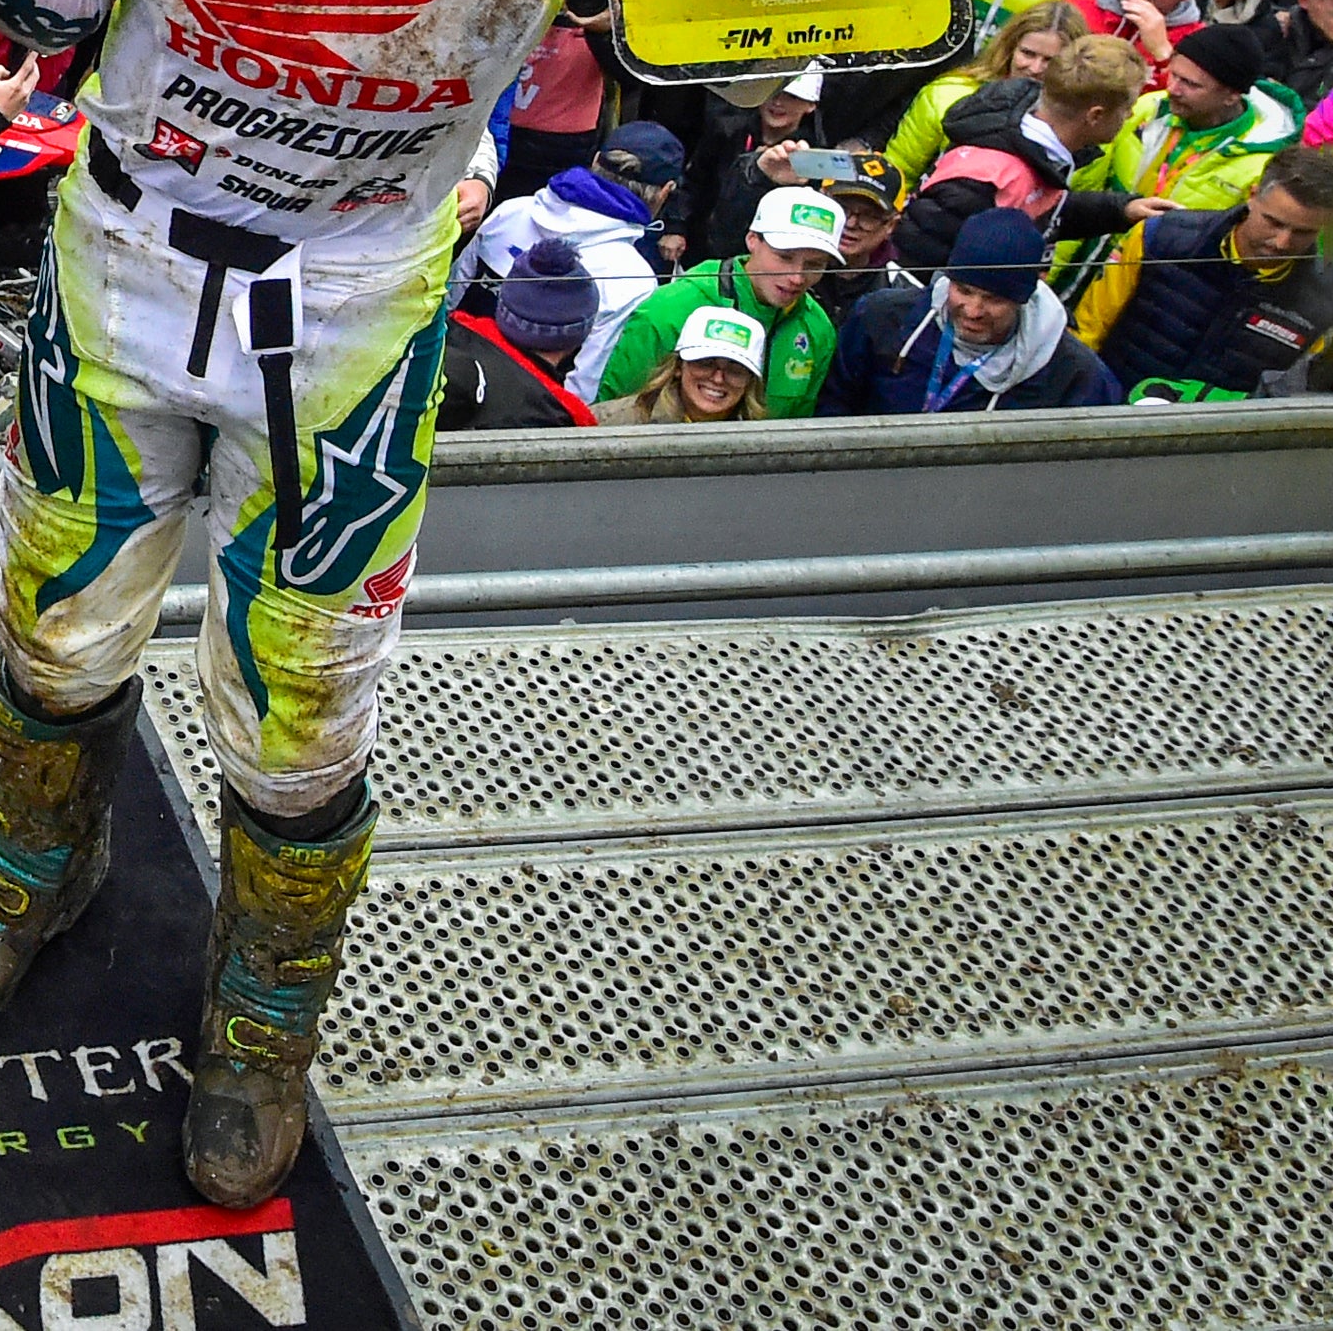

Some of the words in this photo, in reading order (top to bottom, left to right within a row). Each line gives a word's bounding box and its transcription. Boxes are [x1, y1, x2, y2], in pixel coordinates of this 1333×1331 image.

[718, 27, 773, 49] FIM
[165, 16, 474, 113] HONDA
[161, 73, 456, 161] PROGRESSIVE
[232, 154, 338, 190] DUNLOP
[216, 174, 313, 213] SHOWA
